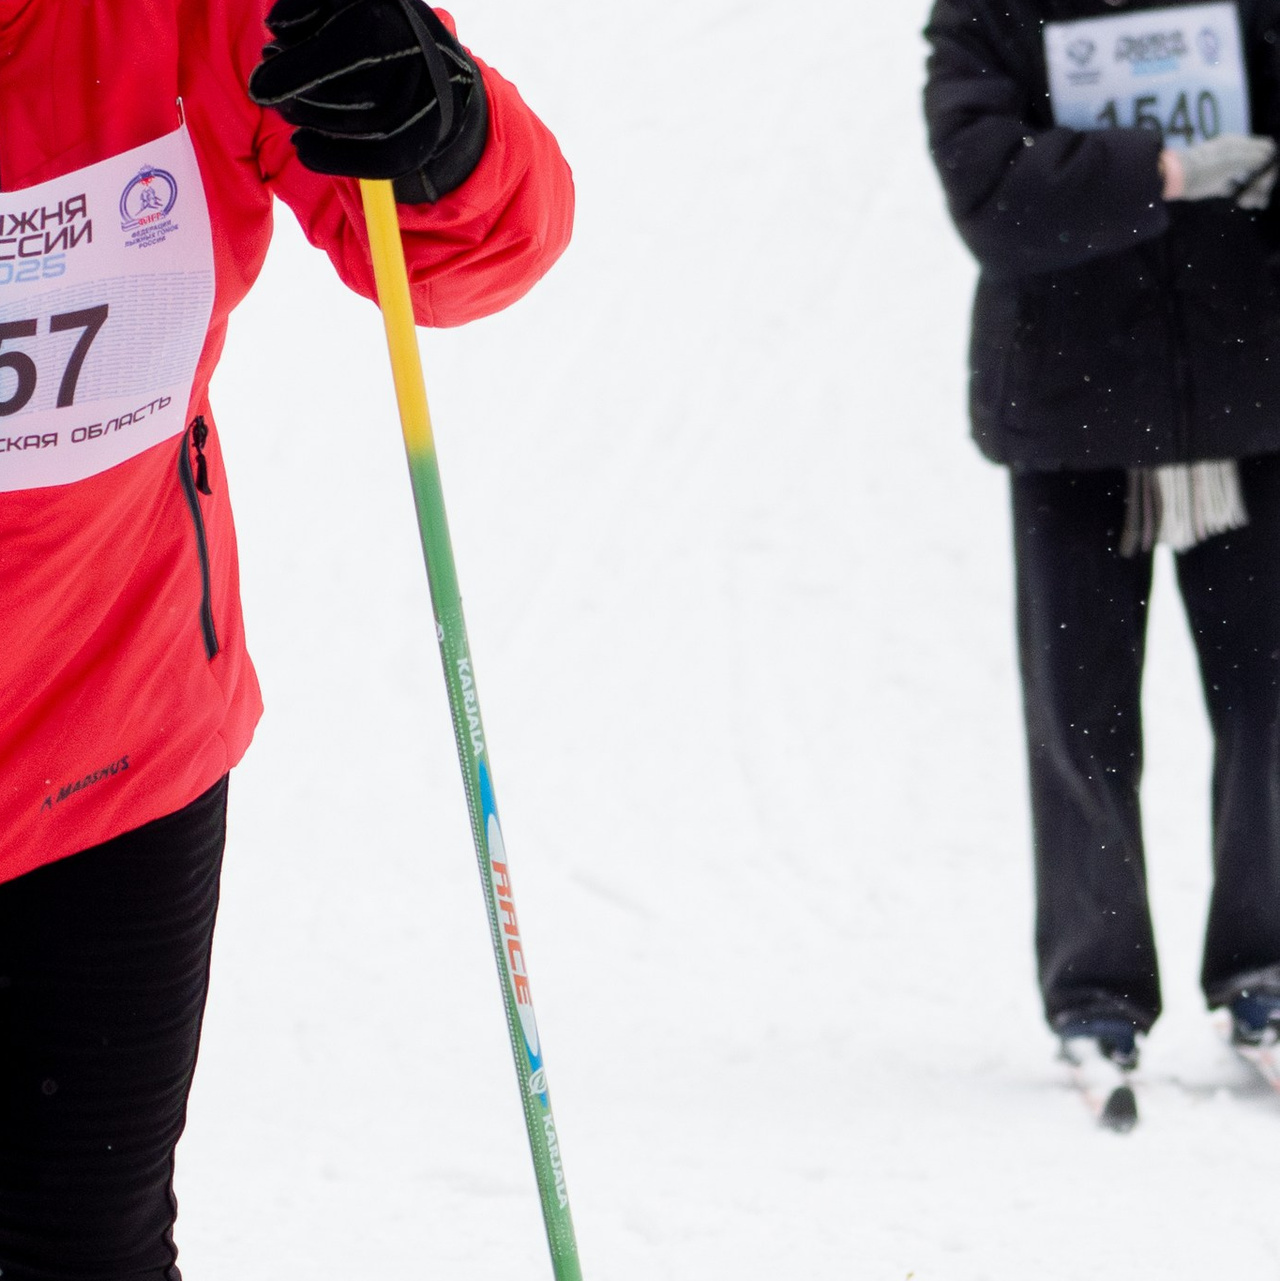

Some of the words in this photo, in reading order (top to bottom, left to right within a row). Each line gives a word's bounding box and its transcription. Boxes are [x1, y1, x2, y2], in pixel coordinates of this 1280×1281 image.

[71, 396, 172, 444] ОБЛАСТЬ
[456, 658, 484, 757] KARJALA
[490, 859, 533, 1007] RACE
[542, 1113, 570, 1210] KARJALA
